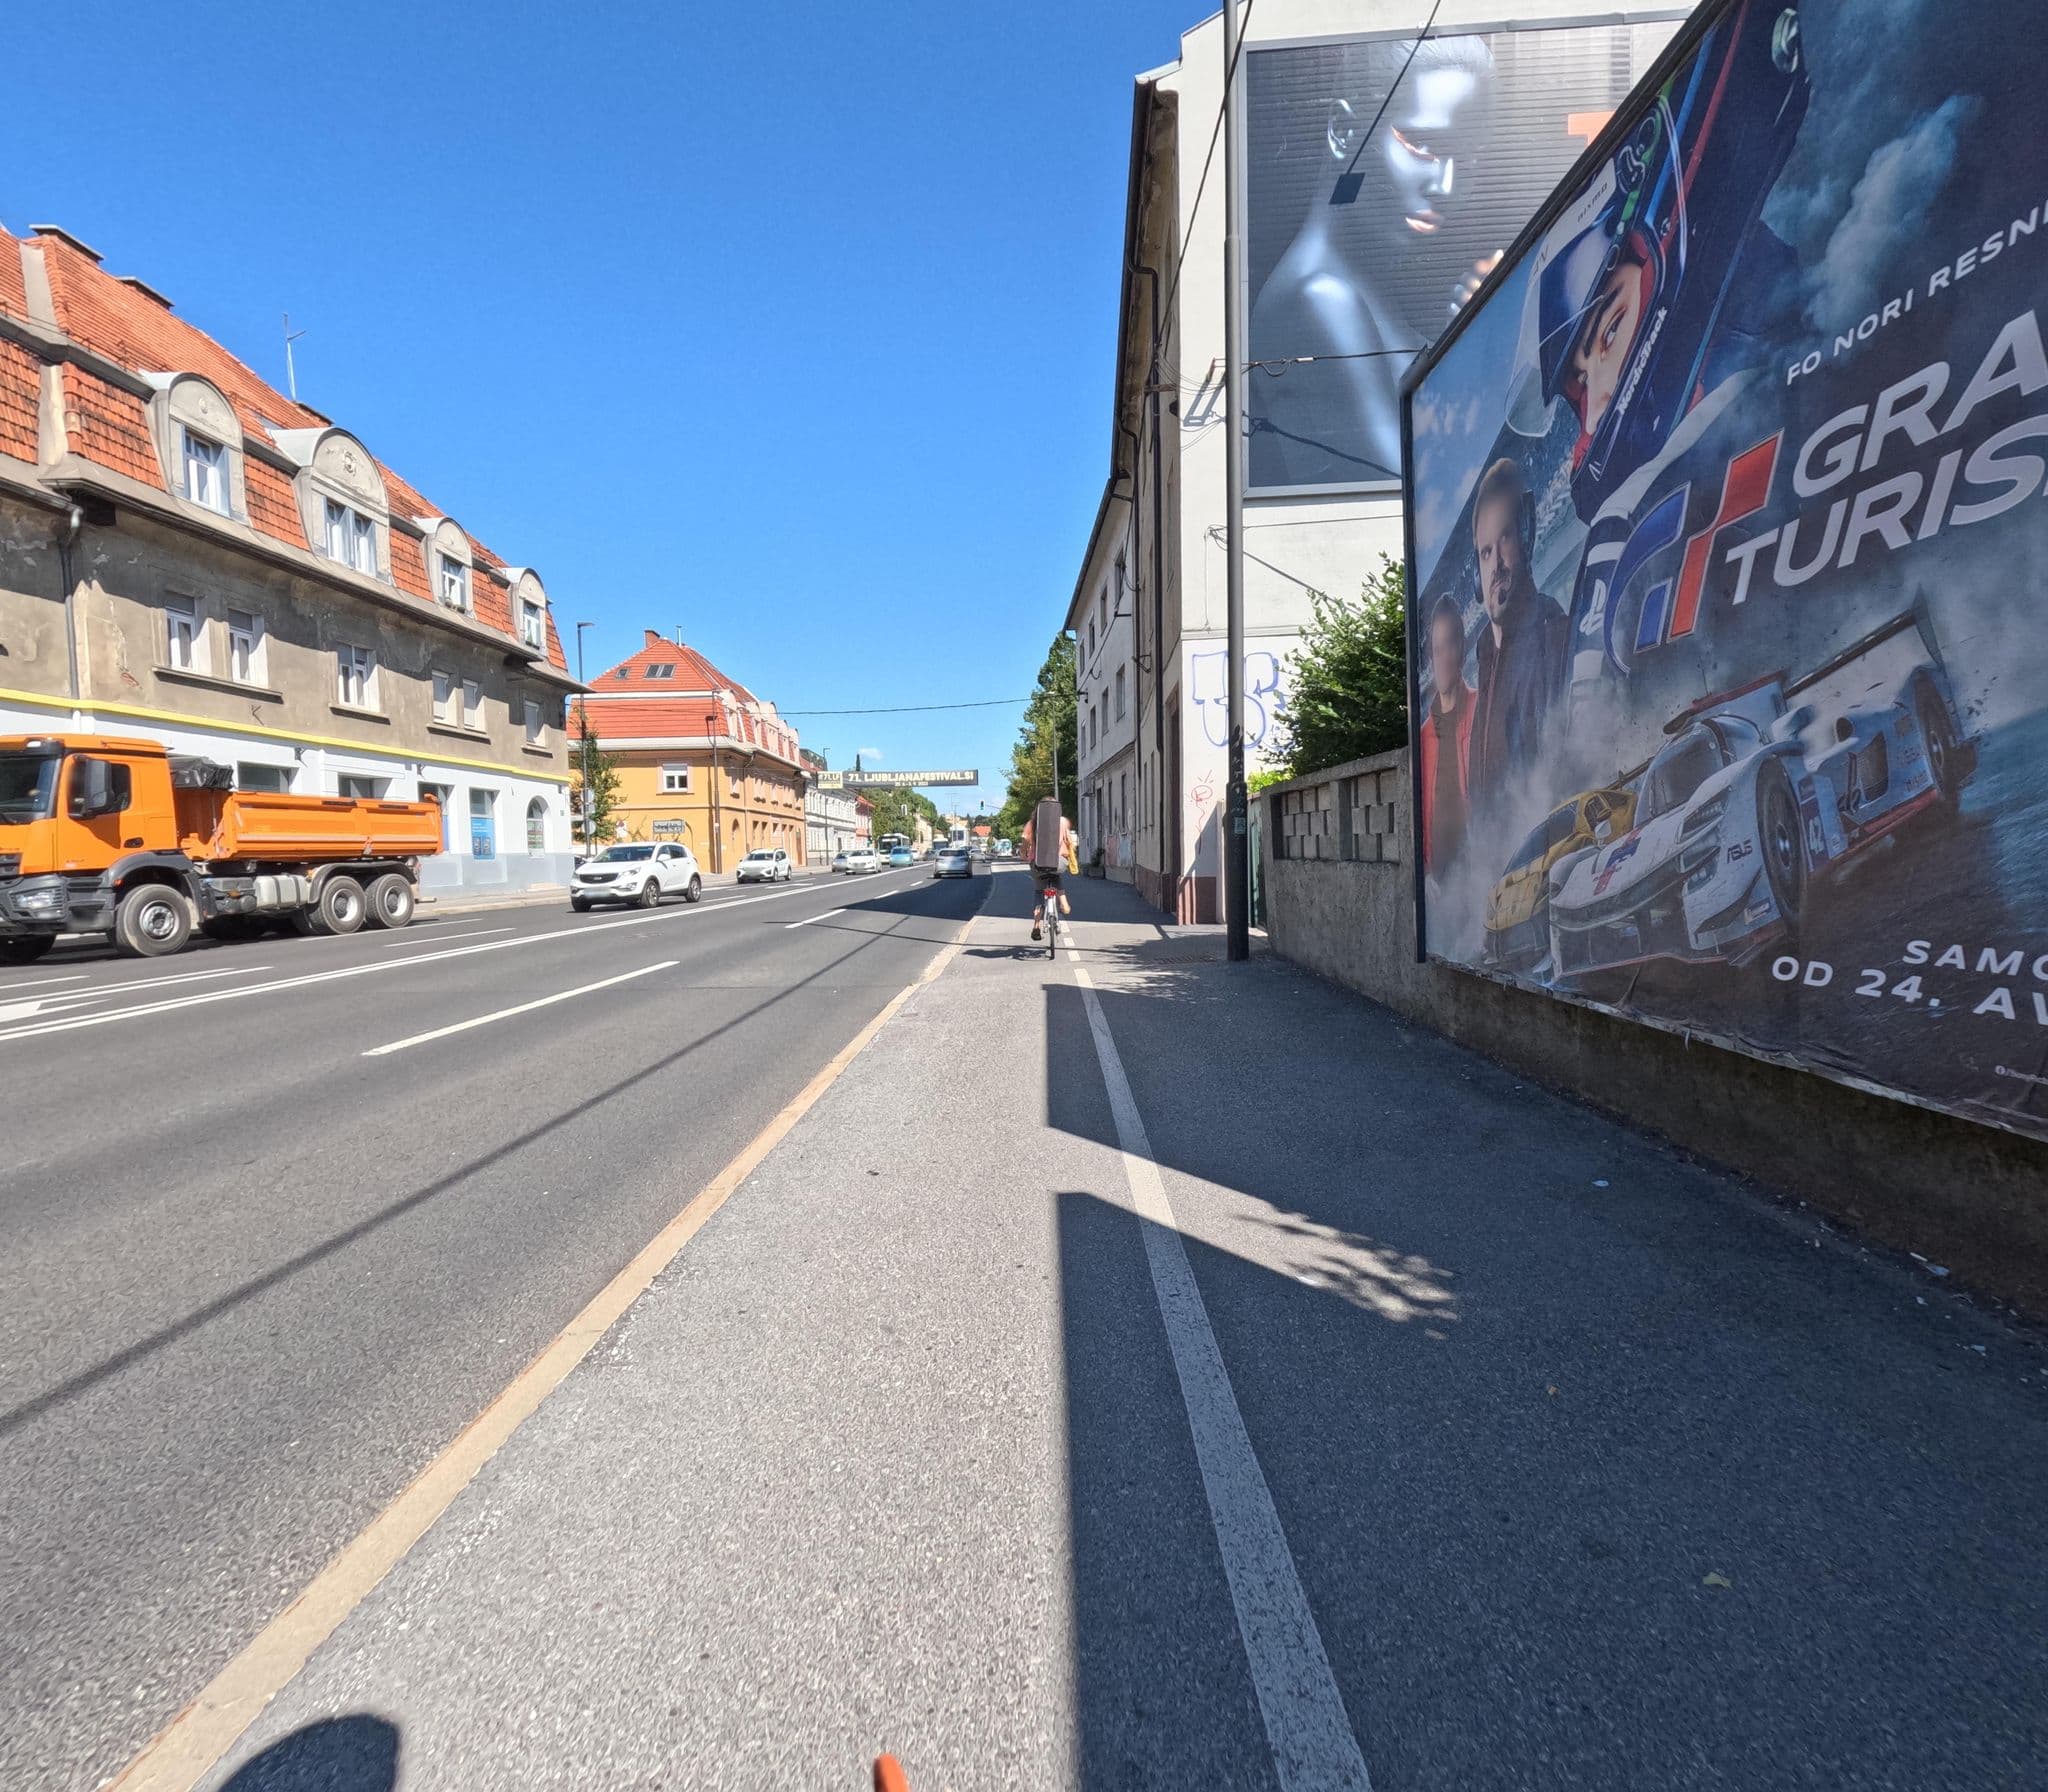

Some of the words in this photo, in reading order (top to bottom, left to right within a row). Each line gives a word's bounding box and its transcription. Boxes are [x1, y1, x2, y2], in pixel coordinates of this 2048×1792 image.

[1617, 306, 1668, 416] NordicTrack
[1787, 350, 1822, 386] FO
[1833, 288, 1914, 356] NORI
[1793, 310, 2048, 497] GRA
[1725, 413, 2048, 606] TURIS
[1772, 956, 1833, 987] OD
[1855, 969, 1940, 1007] 24.
